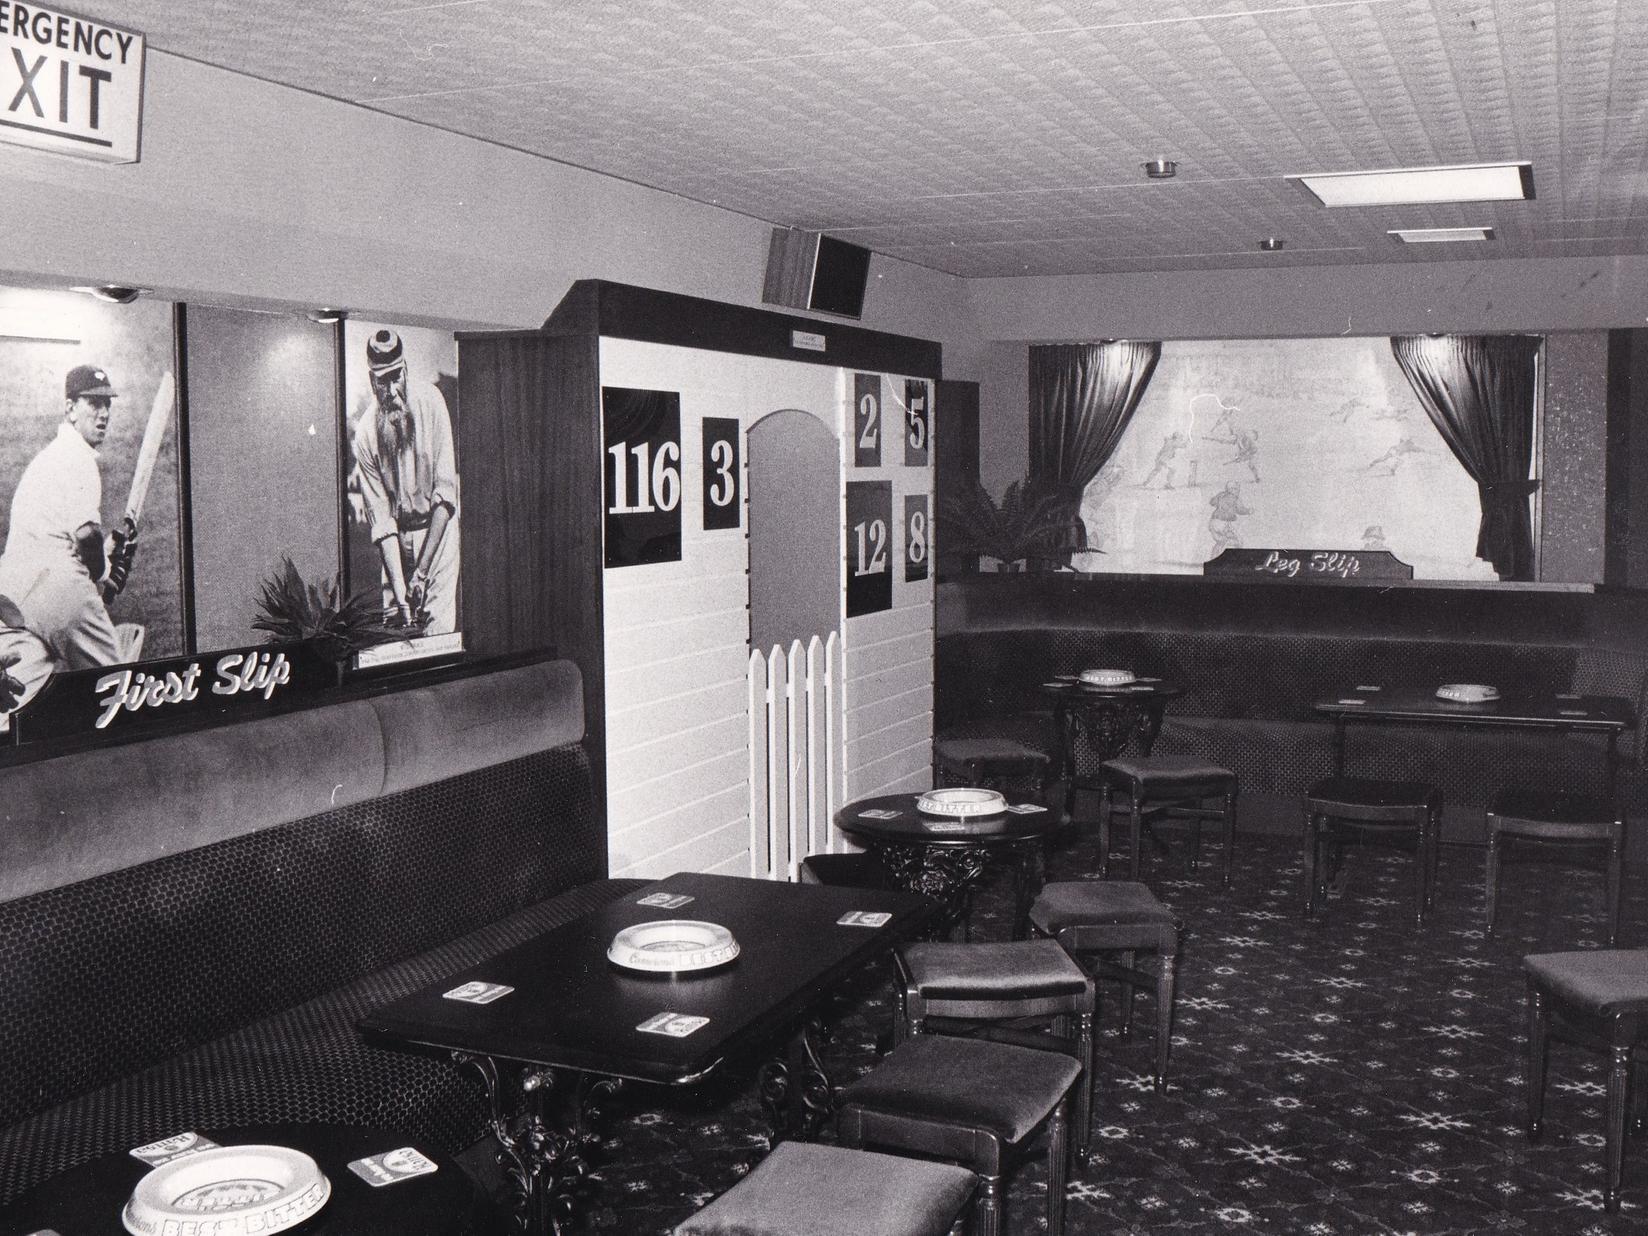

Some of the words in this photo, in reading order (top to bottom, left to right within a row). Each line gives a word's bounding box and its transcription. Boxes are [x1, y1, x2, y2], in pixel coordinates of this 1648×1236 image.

[859, 393, 878, 448] 2
[909, 396, 926, 450] 5
[608, 441, 681, 514] 116
[709, 440, 735, 506] 3
[854, 519, 887, 576] 12
[909, 511, 926, 563] 8
[1255, 551, 1301, 577] Leg
[1311, 552, 1361, 577] Slip
[95, 663, 201, 729] First
[212, 651, 290, 700] Slip
[245, 1183, 325, 1234] BITTER
